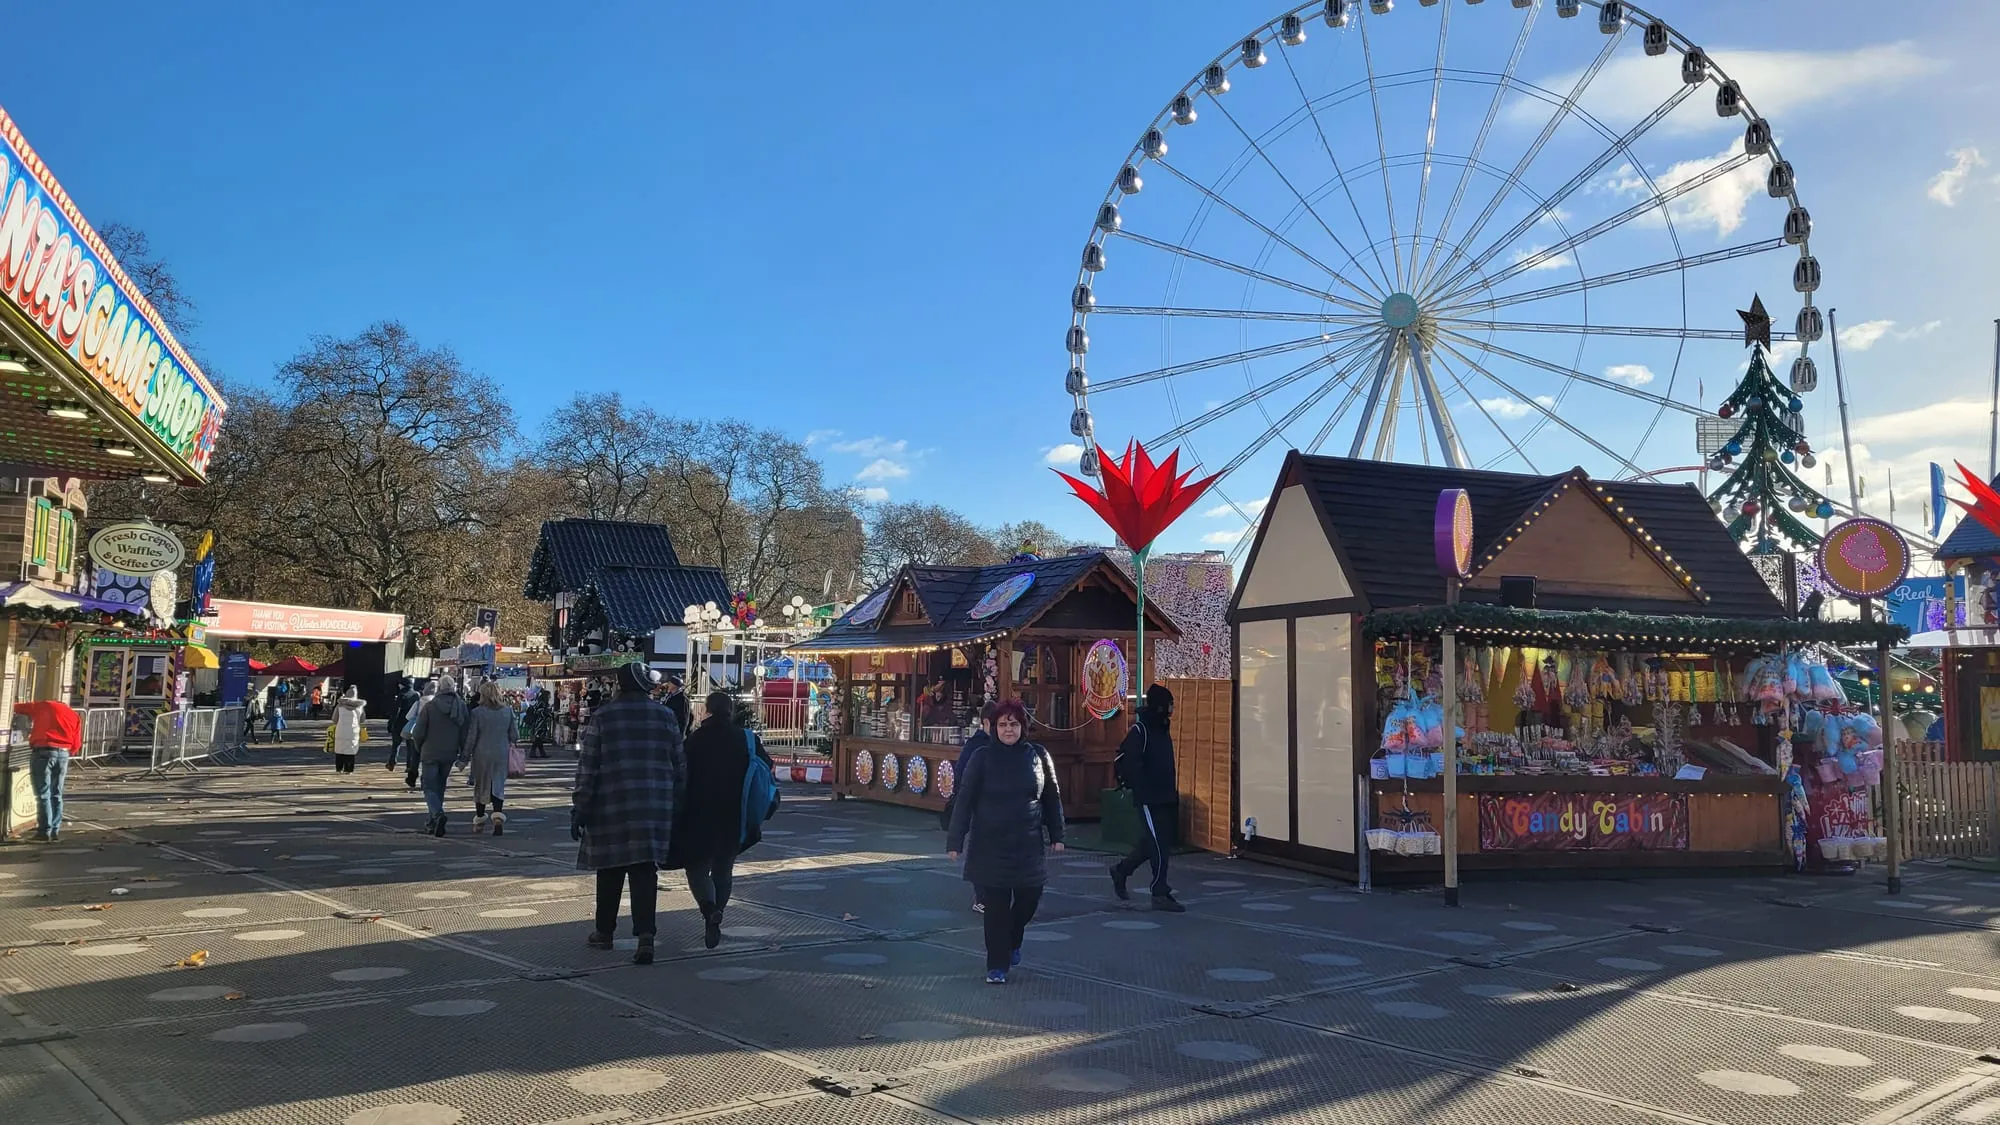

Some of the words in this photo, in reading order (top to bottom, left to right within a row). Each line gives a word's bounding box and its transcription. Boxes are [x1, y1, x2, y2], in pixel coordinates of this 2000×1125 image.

[80, 285, 160, 413] GAME
[145, 358, 203, 452] SHOP
[103, 531, 137, 546] Fresh
[117, 543, 162, 557] Waffles
[103, 551, 112, 560] &
[112, 555, 148, 568] Coffee
[1894, 585, 1934, 601] Real
